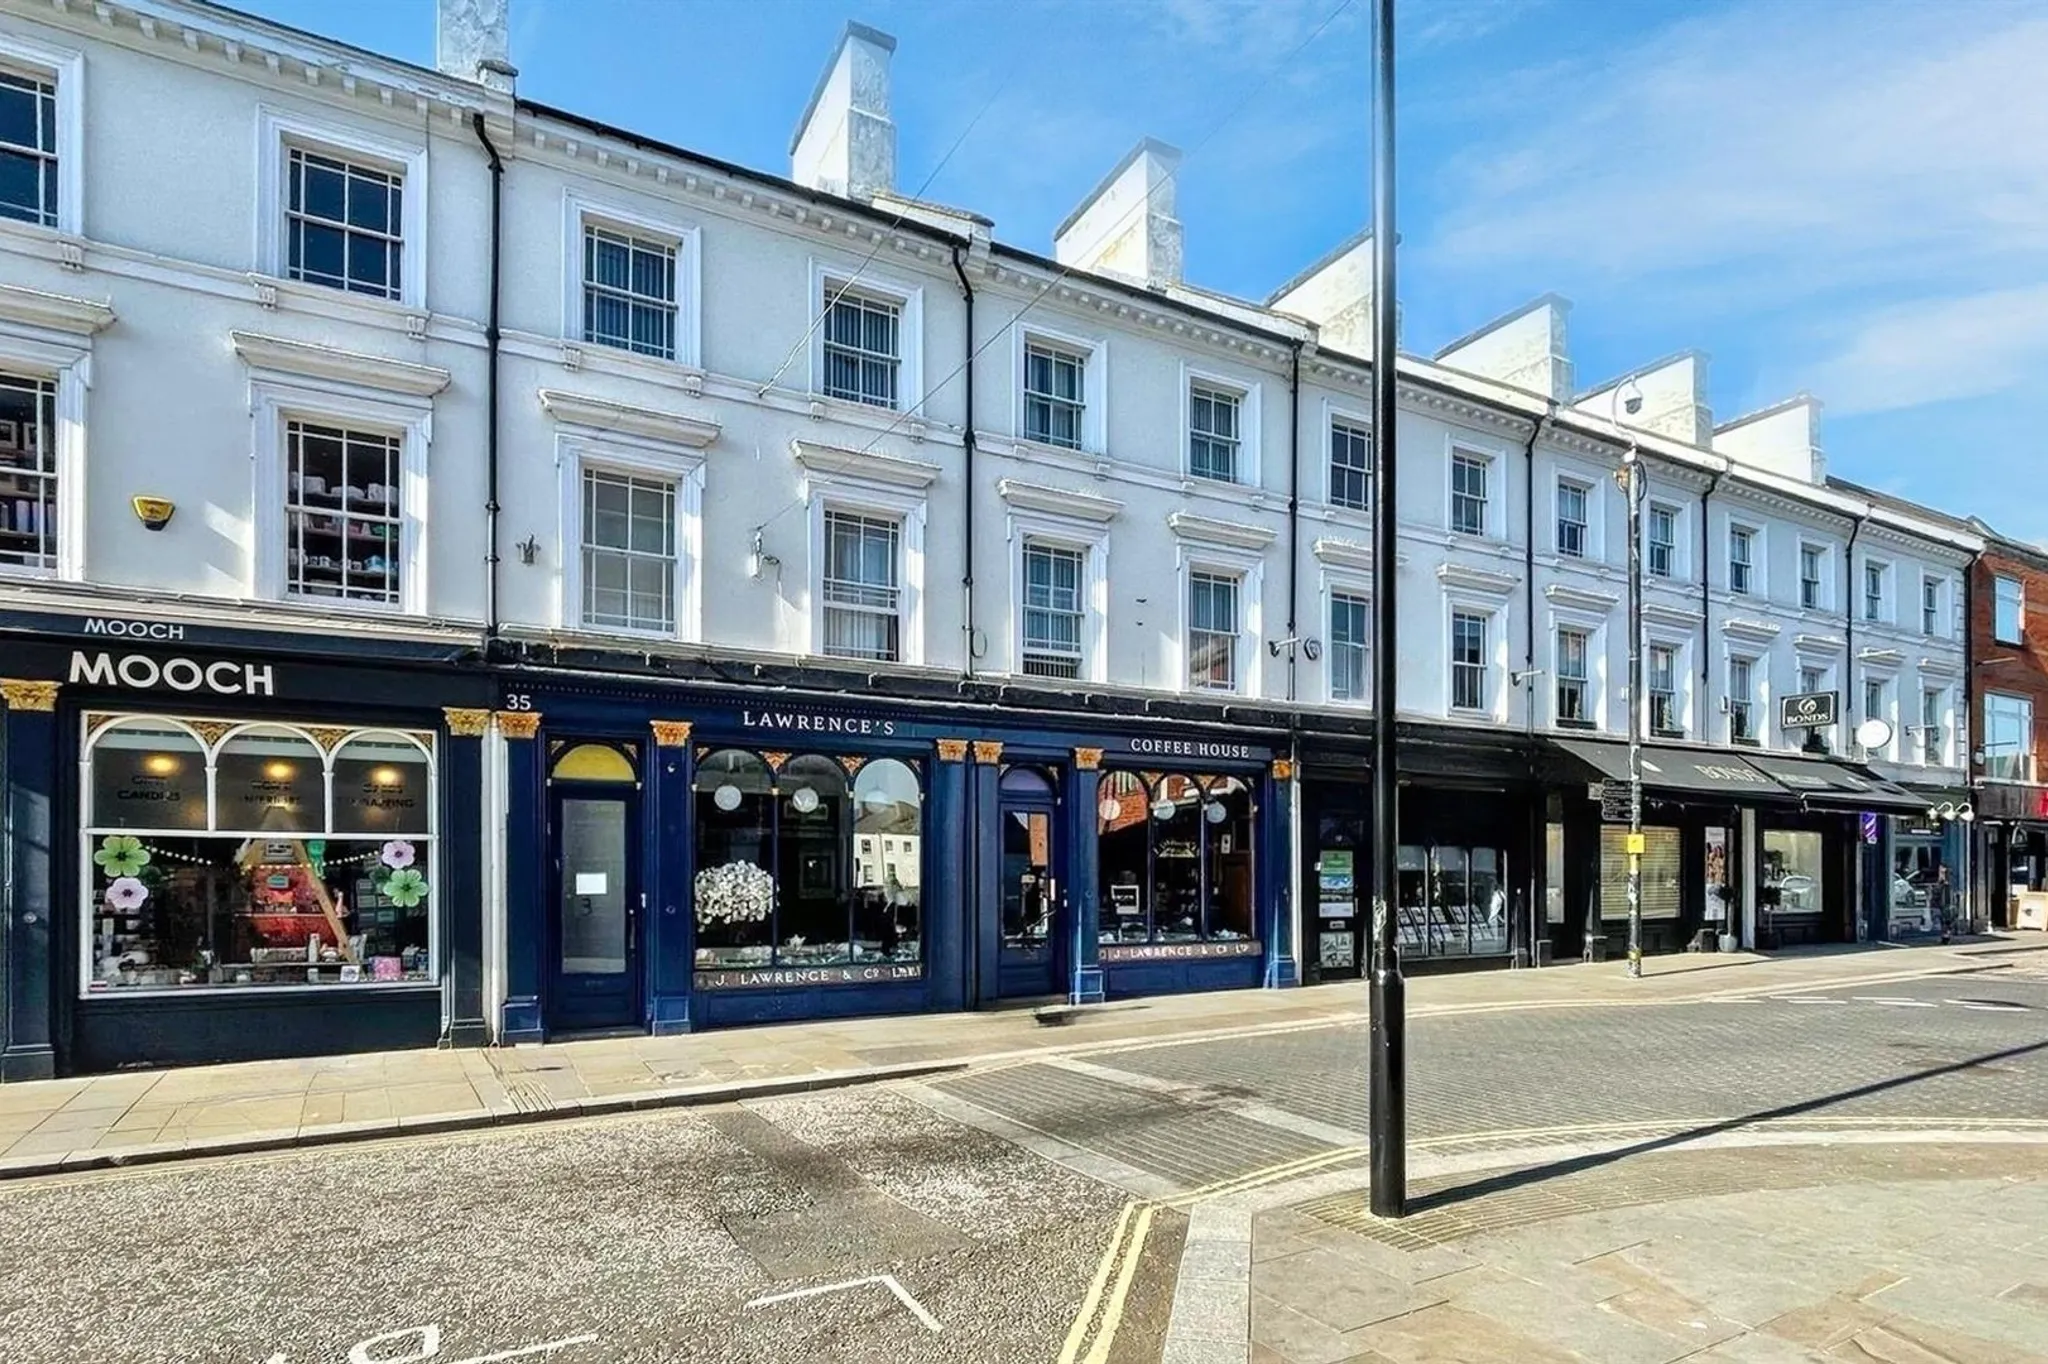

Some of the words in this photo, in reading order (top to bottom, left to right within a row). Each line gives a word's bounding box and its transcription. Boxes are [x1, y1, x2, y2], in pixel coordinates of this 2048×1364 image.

[83, 617, 185, 640] MOOCH
[68, 651, 274, 696] MOOCH
[506, 693, 532, 711] 35
[743, 710, 895, 736] LAWRENCE'S
[1786, 713, 1829, 724] BONDS
[1130, 738, 1192, 755] COFFEE
[1199, 742, 1250, 758] HOUSE
[1130, 945, 1192, 958] LAWRENCE
[741, 970, 829, 985] LAWRENCE
[843, 971, 852, 981] &
